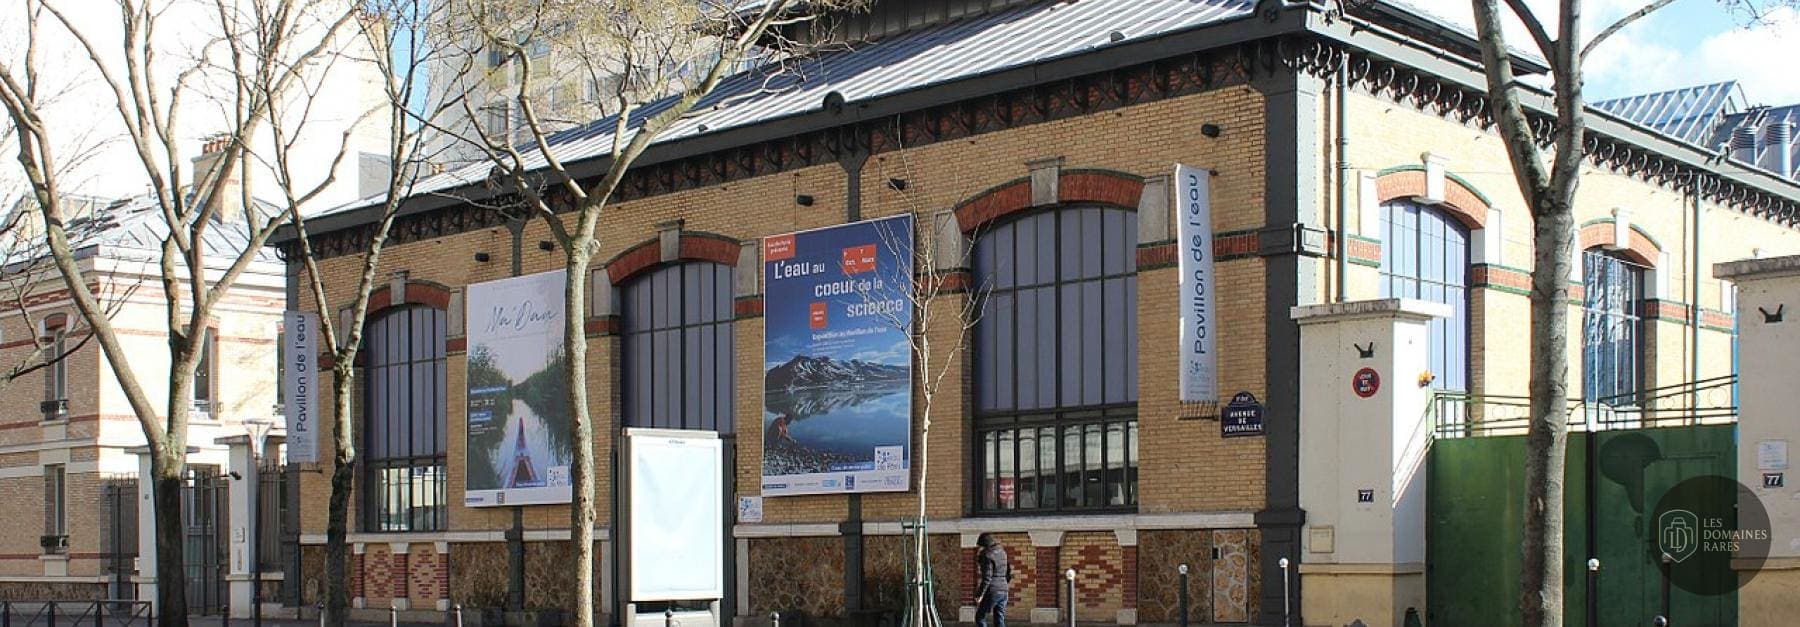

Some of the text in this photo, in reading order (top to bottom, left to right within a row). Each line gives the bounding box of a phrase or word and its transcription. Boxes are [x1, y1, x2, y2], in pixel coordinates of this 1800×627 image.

[1189, 174, 1201, 226] l'eau
[1191, 234, 1203, 262] de
[774, 260, 825, 279] L'eau au
[815, 278, 883, 297] coeur de la
[847, 299, 904, 318] science
[1193, 270, 1206, 354] Pavillon
[295, 314, 307, 432] Pavillon de l'eau
[1230, 410, 1256, 418] AVENUE
[1224, 423, 1262, 433] VERSAILLES
[1767, 475, 1780, 485] 77
[1360, 491, 1371, 501] 77
